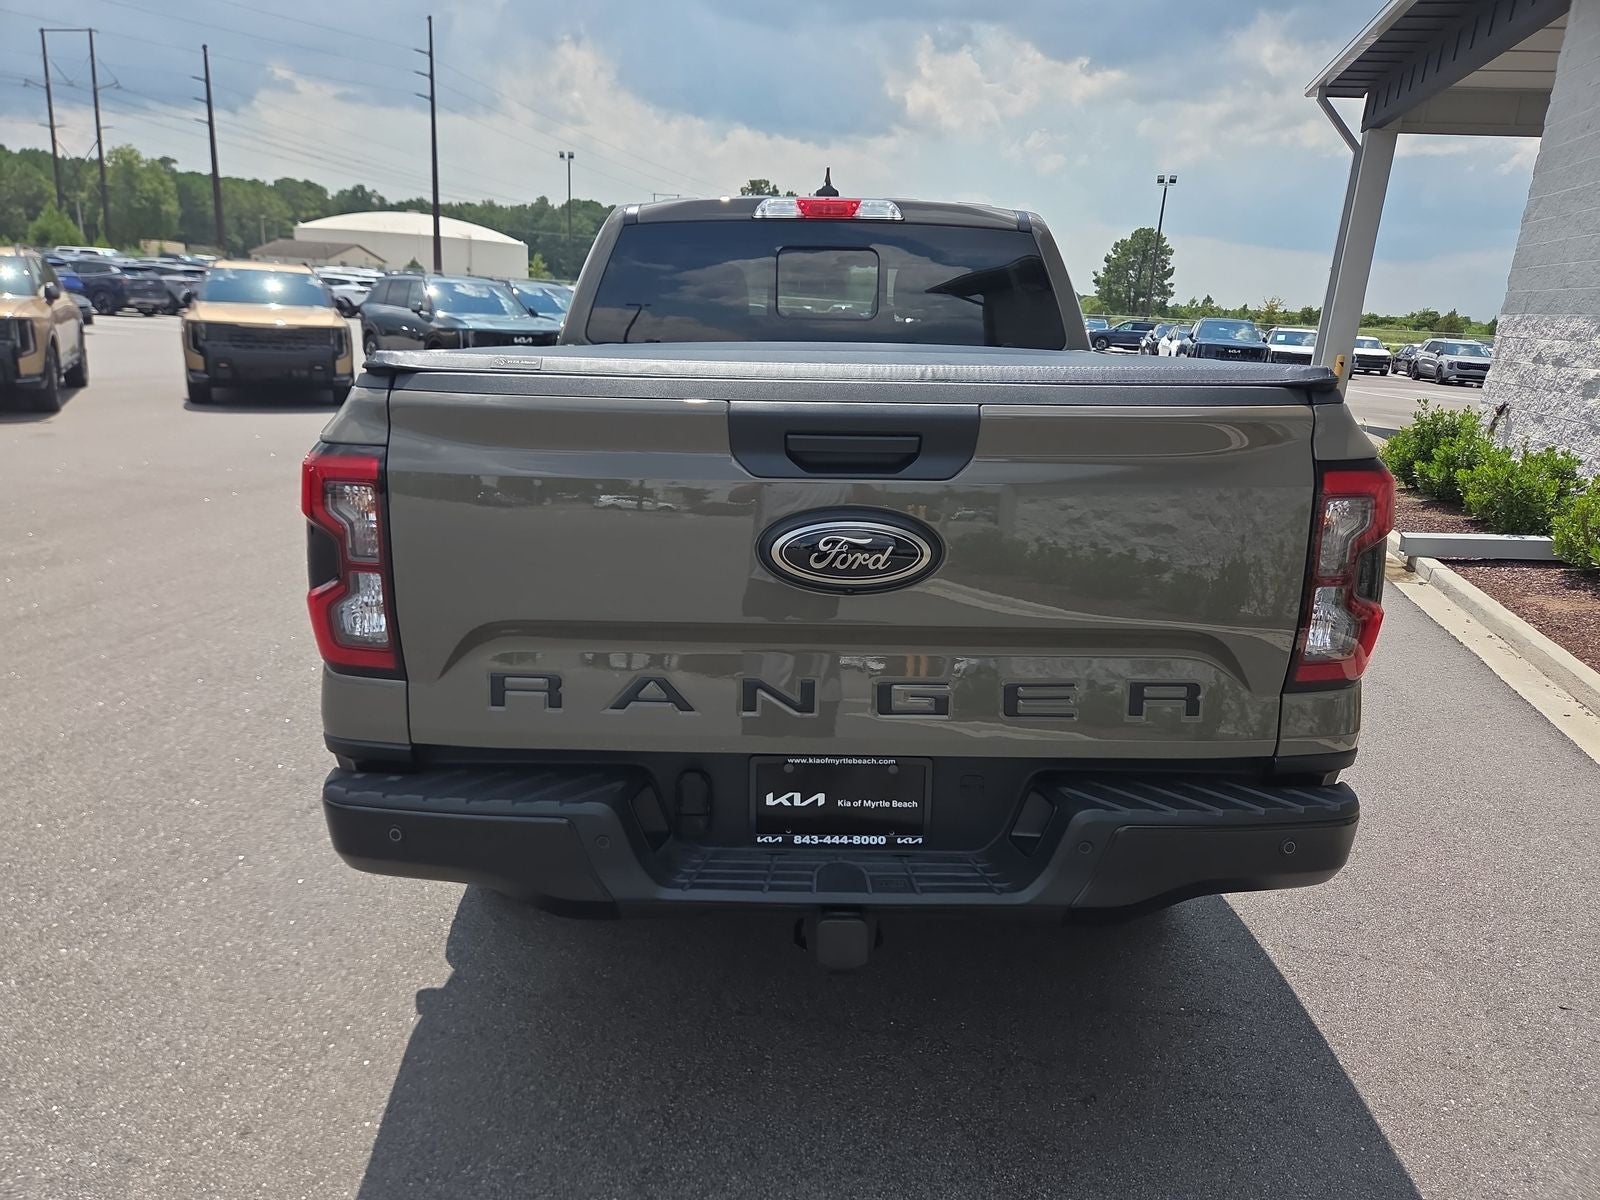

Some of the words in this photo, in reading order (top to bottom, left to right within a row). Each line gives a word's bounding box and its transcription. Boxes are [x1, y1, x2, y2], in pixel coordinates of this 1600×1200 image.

[809, 535, 894, 570] Ford
[489, 672, 1201, 718] RANGER
[787, 757, 896, 766] www.kiaofmyrtlebeach.com
[765, 791, 826, 807] KIA
[837, 799, 851, 808] Kia
[852, 799, 862, 808] of
[863, 799, 890, 809] Myrtle
[891, 800, 918, 808] Beach
[793, 835, 887, 845] 843-444-8000
